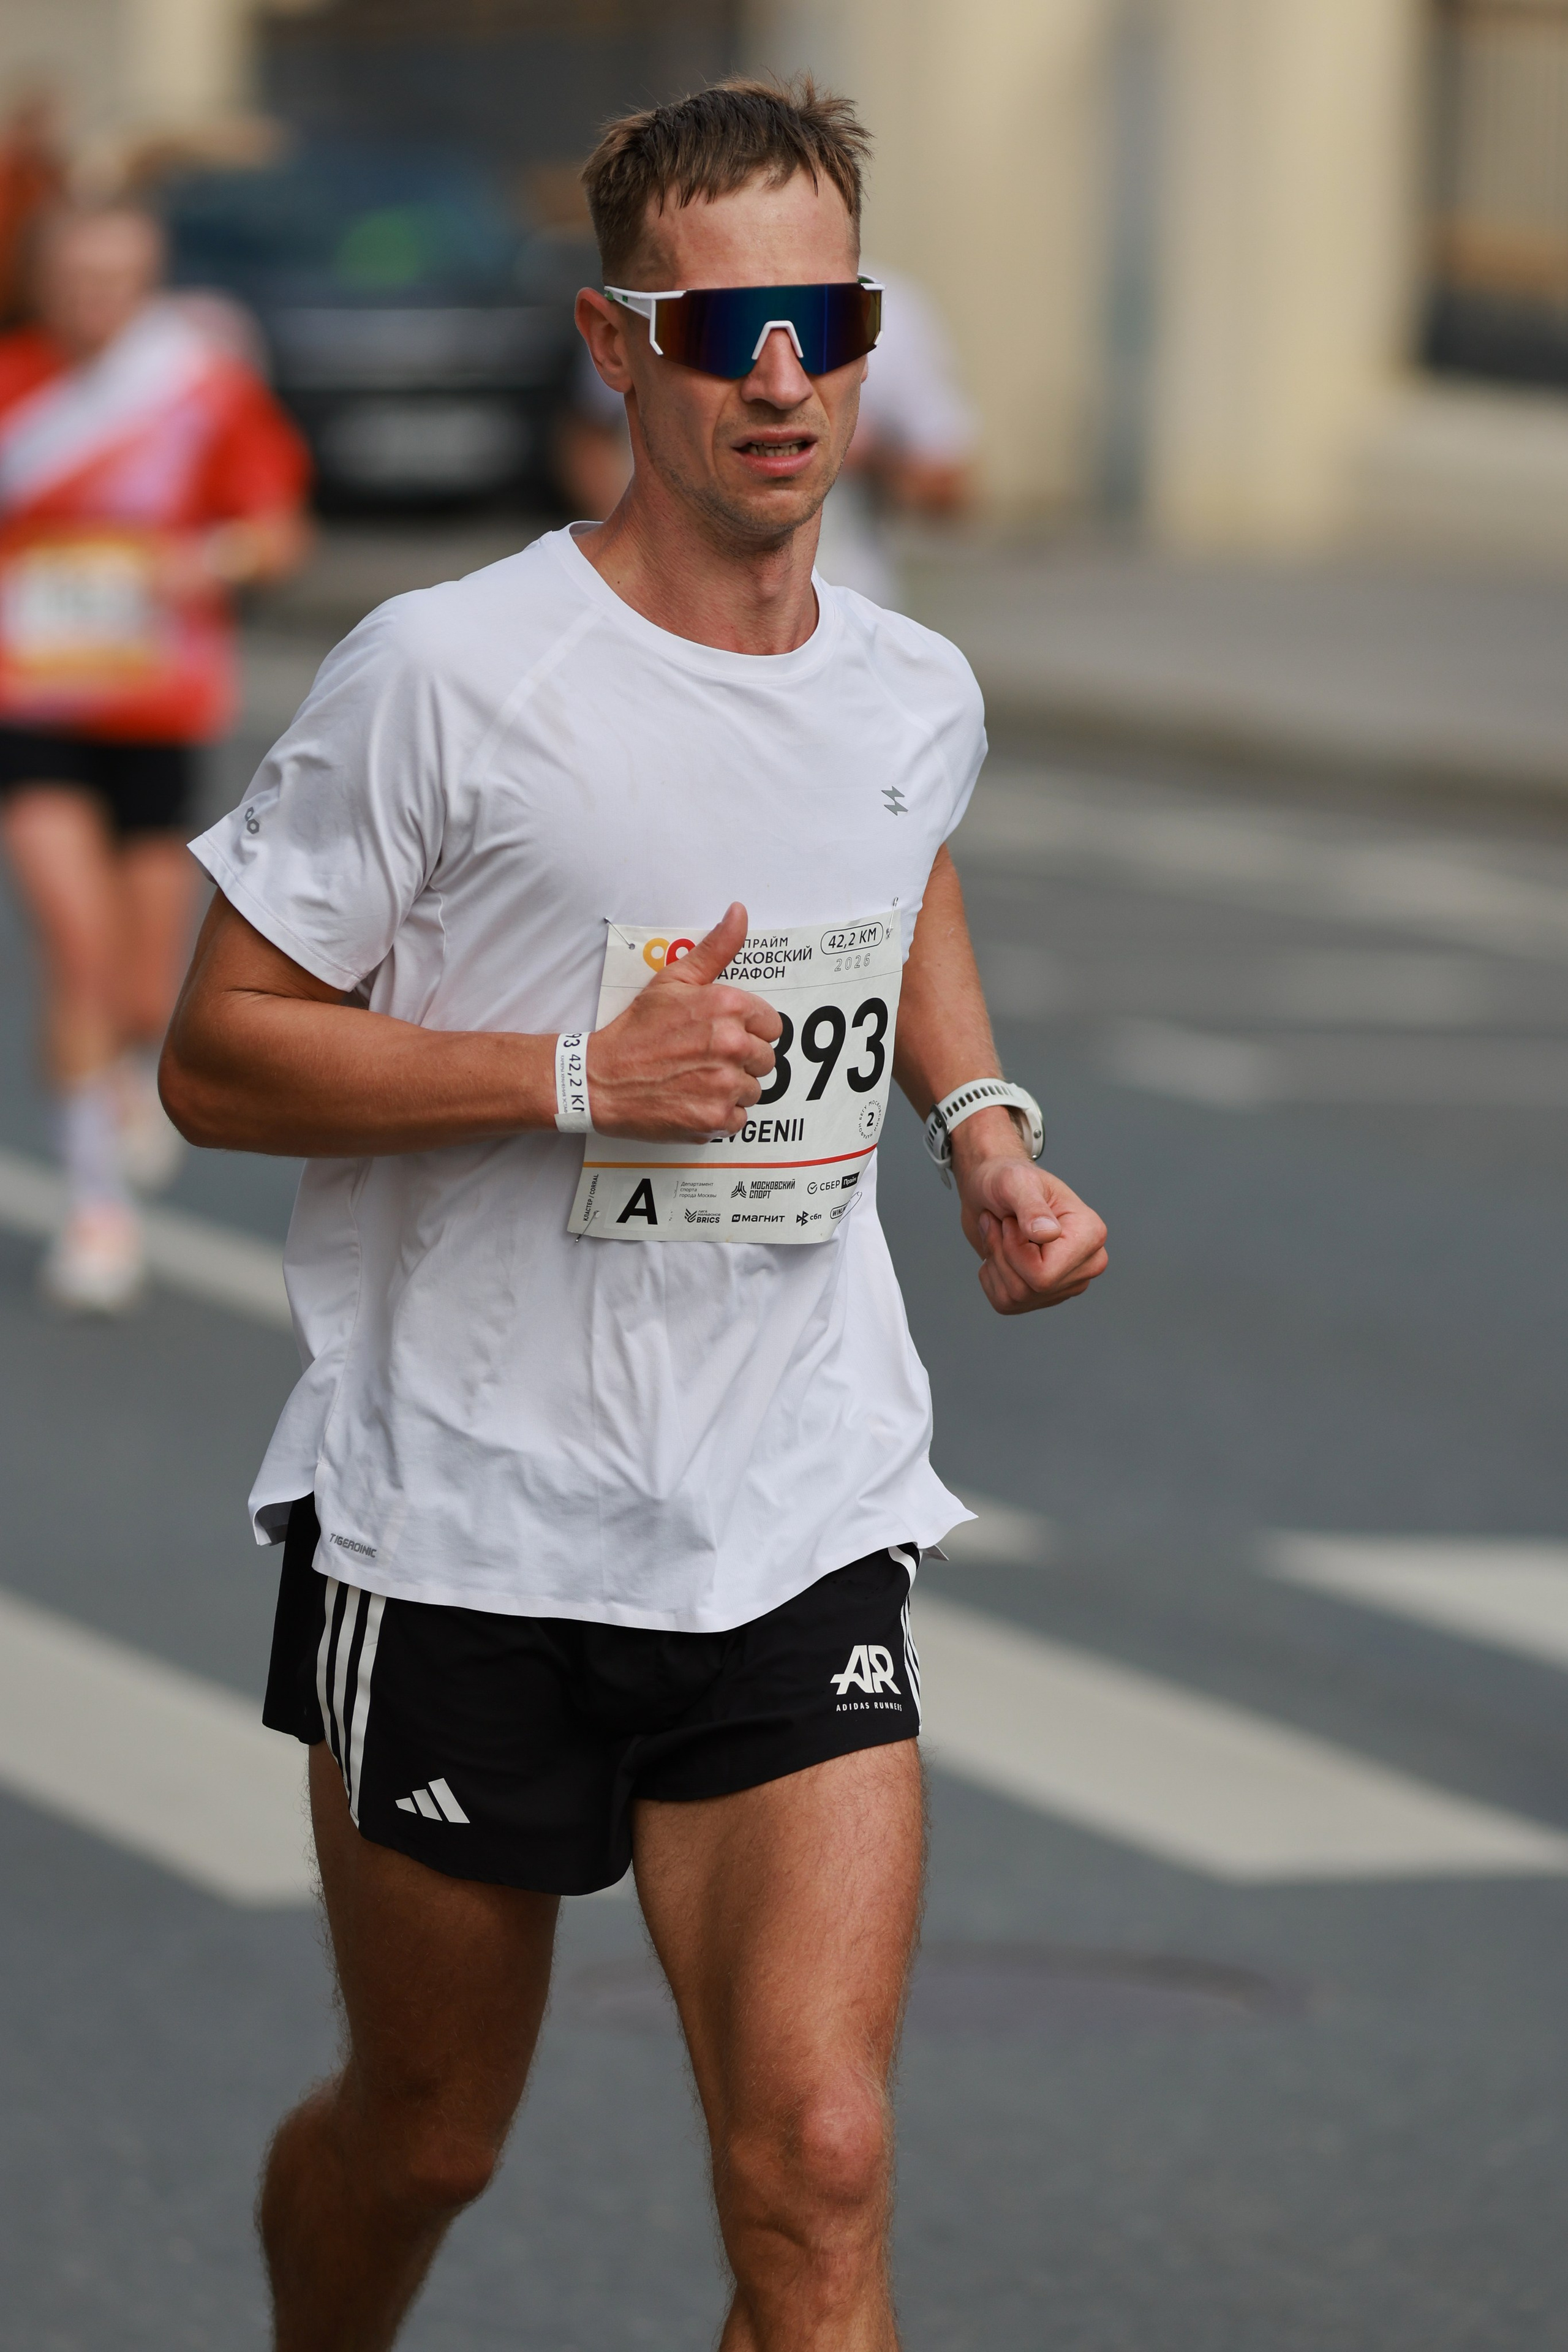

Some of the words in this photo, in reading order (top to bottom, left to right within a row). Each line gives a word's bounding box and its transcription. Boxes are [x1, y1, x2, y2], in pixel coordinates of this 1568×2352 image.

[828, 932, 856, 949] 42,2
[733, 945, 812, 965] СКОВСКИЙ
[834, 953, 870, 971] 2026
[717, 965, 785, 980] АРАФОН
[567, 1054, 582, 1087] 42,2
[866, 1112, 875, 1127] 2
[710, 1118, 804, 1143] GENII
[750, 1178, 796, 1189] МОСКОВСКИЙ
[820, 1180, 840, 1191] СБЕР
[583, 1198, 593, 1221] КЛАСТЕР
[589, 1174, 599, 1195] CORRAL
[616, 1178, 658, 1225] A
[749, 1190, 771, 1199] СПОРТ
[836, 1702, 870, 1711] ADIDAS
[874, 1702, 902, 1712] RUNNERS
